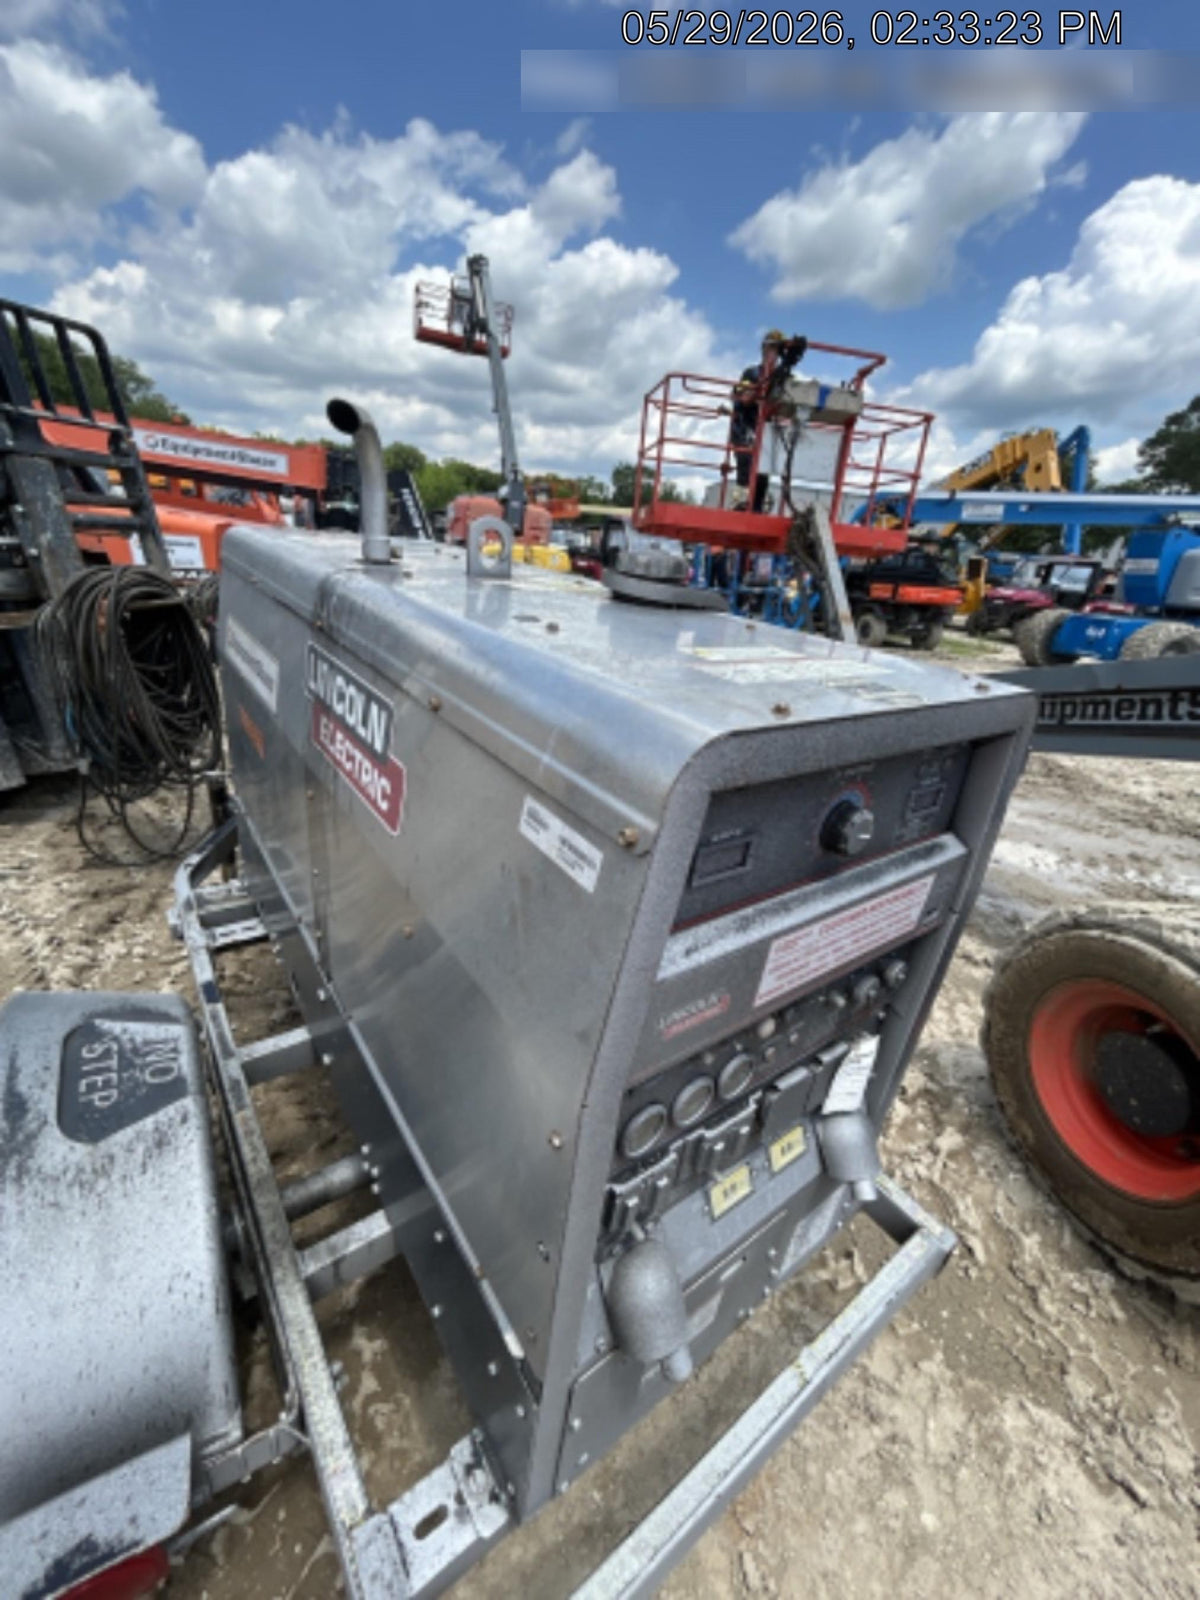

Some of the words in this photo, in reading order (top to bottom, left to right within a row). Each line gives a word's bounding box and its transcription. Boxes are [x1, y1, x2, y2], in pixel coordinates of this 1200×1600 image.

[308, 652, 388, 754] LINCOLN
[319, 712, 392, 813] ELECTRIC
[78, 1034, 119, 1109] STEP
[144, 1036, 182, 1084] NO
